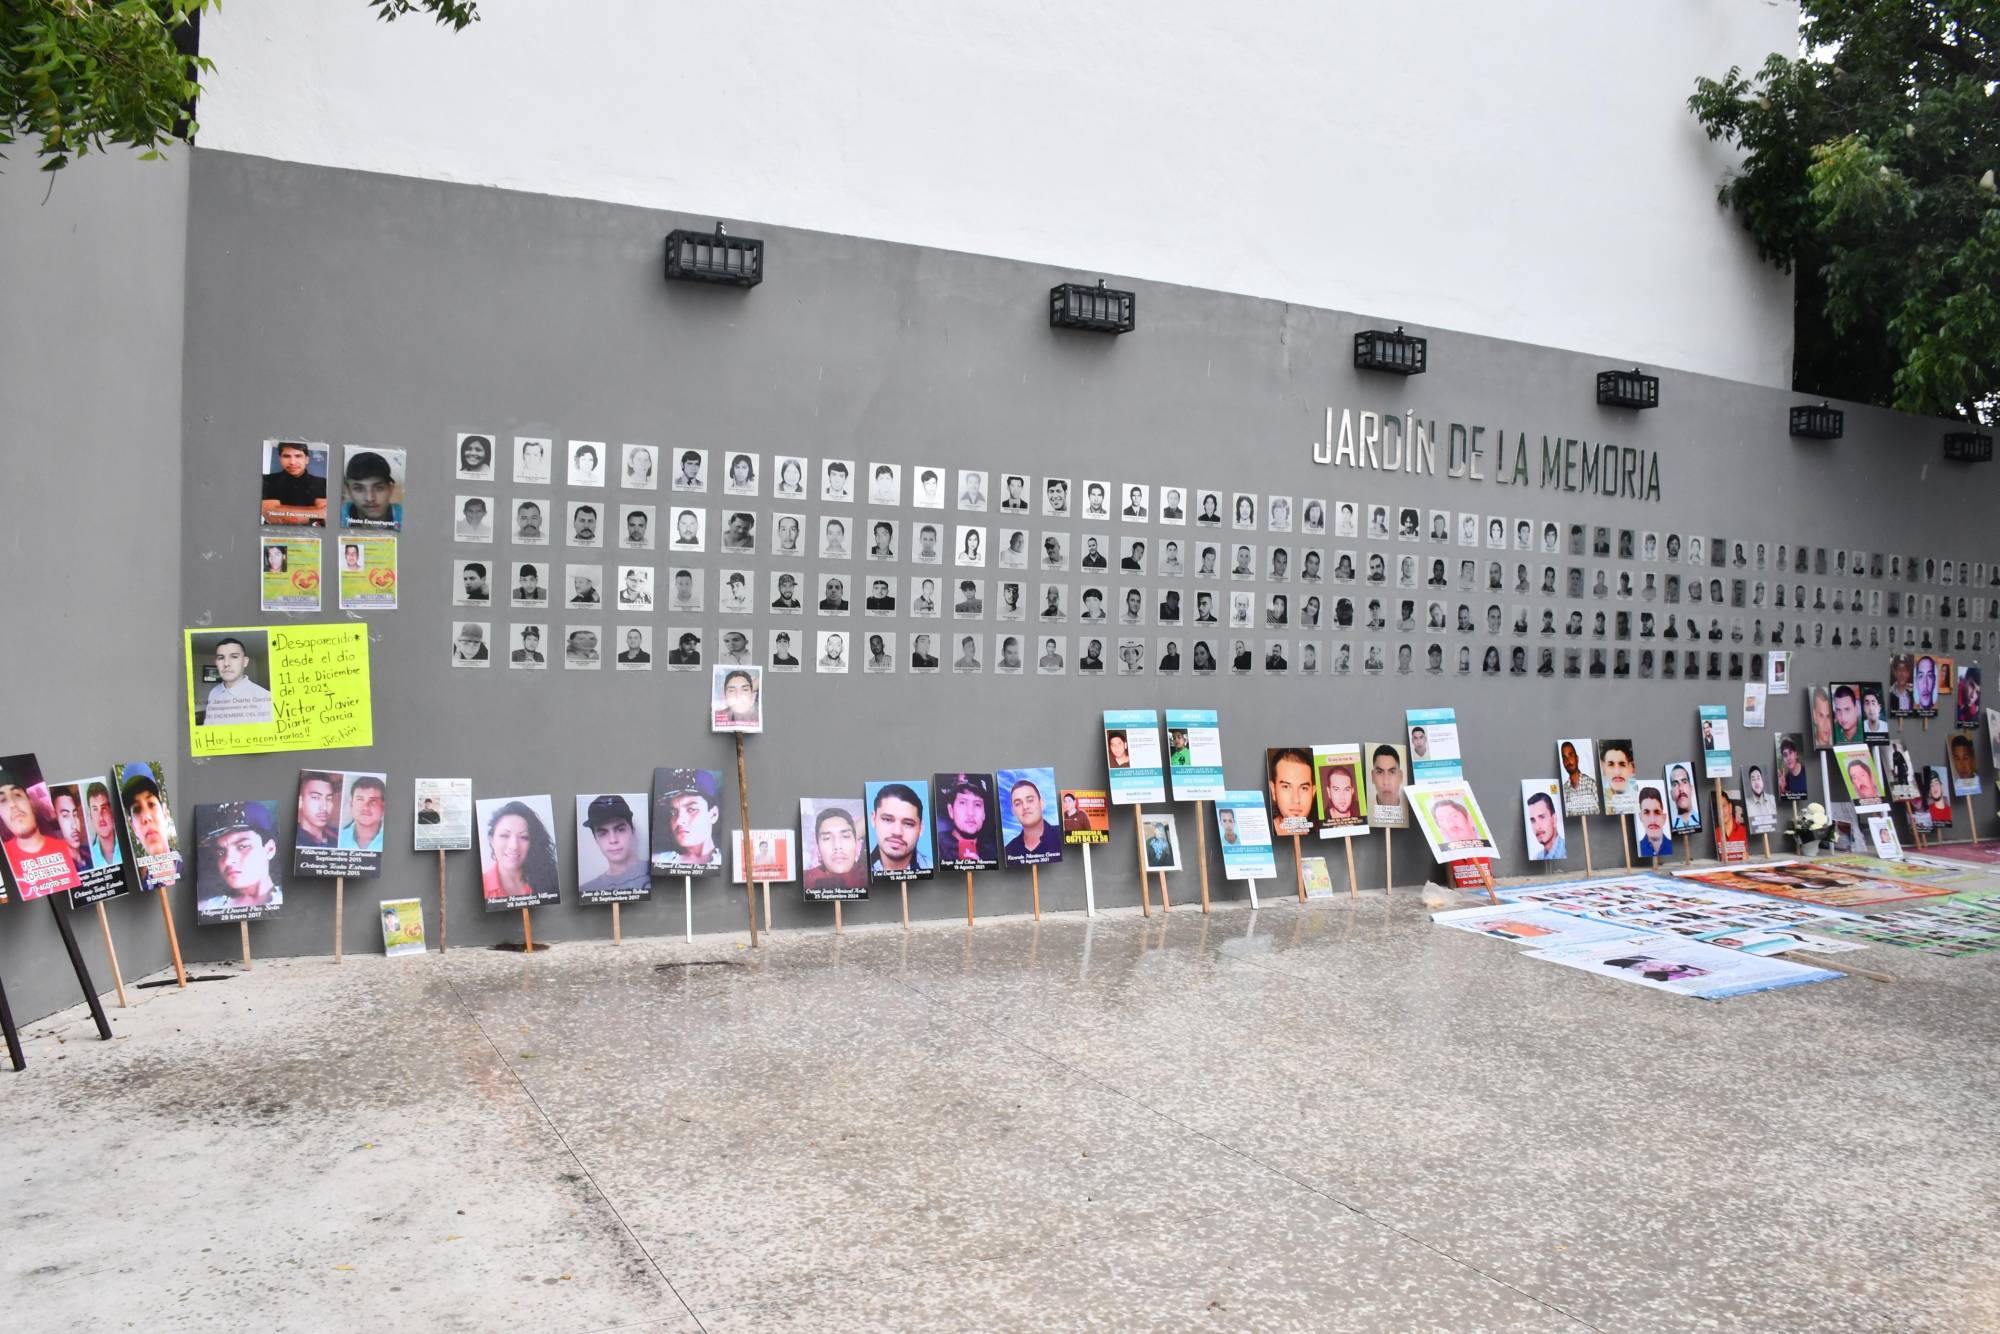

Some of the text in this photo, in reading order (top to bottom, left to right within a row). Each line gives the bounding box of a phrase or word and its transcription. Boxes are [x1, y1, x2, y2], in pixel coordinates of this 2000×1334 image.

[1313, 407, 1661, 502] JARDÍN DE LA MEMORIA
[282, 654, 313, 668] desde
[321, 651, 331, 663] el
[279, 672, 292, 685] 11
[298, 672, 310, 683] de
[280, 685, 295, 697] del
[274, 698, 315, 718] Victor
